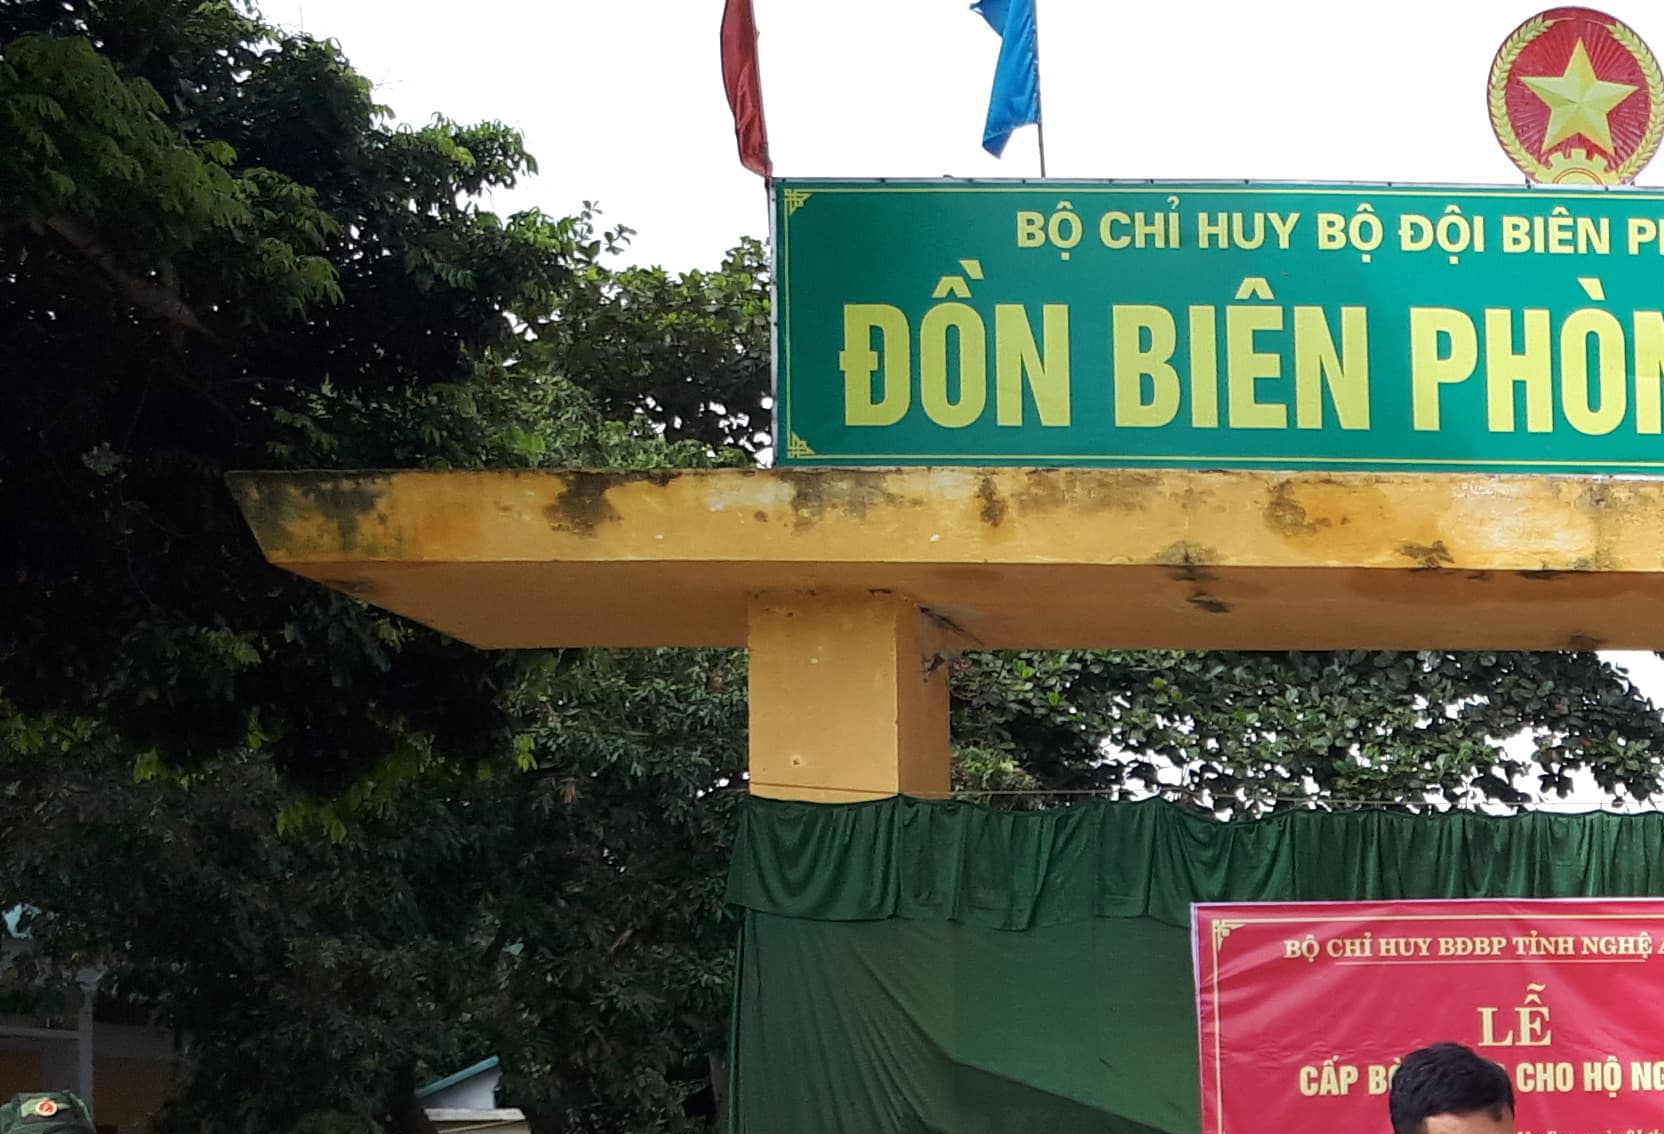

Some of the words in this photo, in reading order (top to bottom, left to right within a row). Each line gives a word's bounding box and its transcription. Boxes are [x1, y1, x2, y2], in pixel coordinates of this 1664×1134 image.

[1016, 200, 1083, 261] BỘ
[1099, 195, 1181, 250] CHỈ
[1197, 212, 1301, 250] HUY
[1317, 202, 1384, 263] BỘ
[1397, 204, 1485, 265] ĐỘI
[1501, 206, 1610, 255] BIÊN
[839, 259, 1071, 430] ĐỒN
[1112, 277, 1371, 431] BIÊN
[1284, 934, 1320, 963] BỘ
[1327, 932, 1372, 958] CHỈ
[1379, 937, 1433, 957] HUY
[1438, 936, 1507, 956] BĐBP
[1513, 930, 1575, 956] TỈNH
[1581, 931, 1652, 959] NGHỆ
[1476, 983, 1552, 1046] LỄ
[1299, 1055, 1359, 1096] CẤP
[1516, 1061, 1575, 1092] CHO
[1583, 1055, 1622, 1098] HỘ
